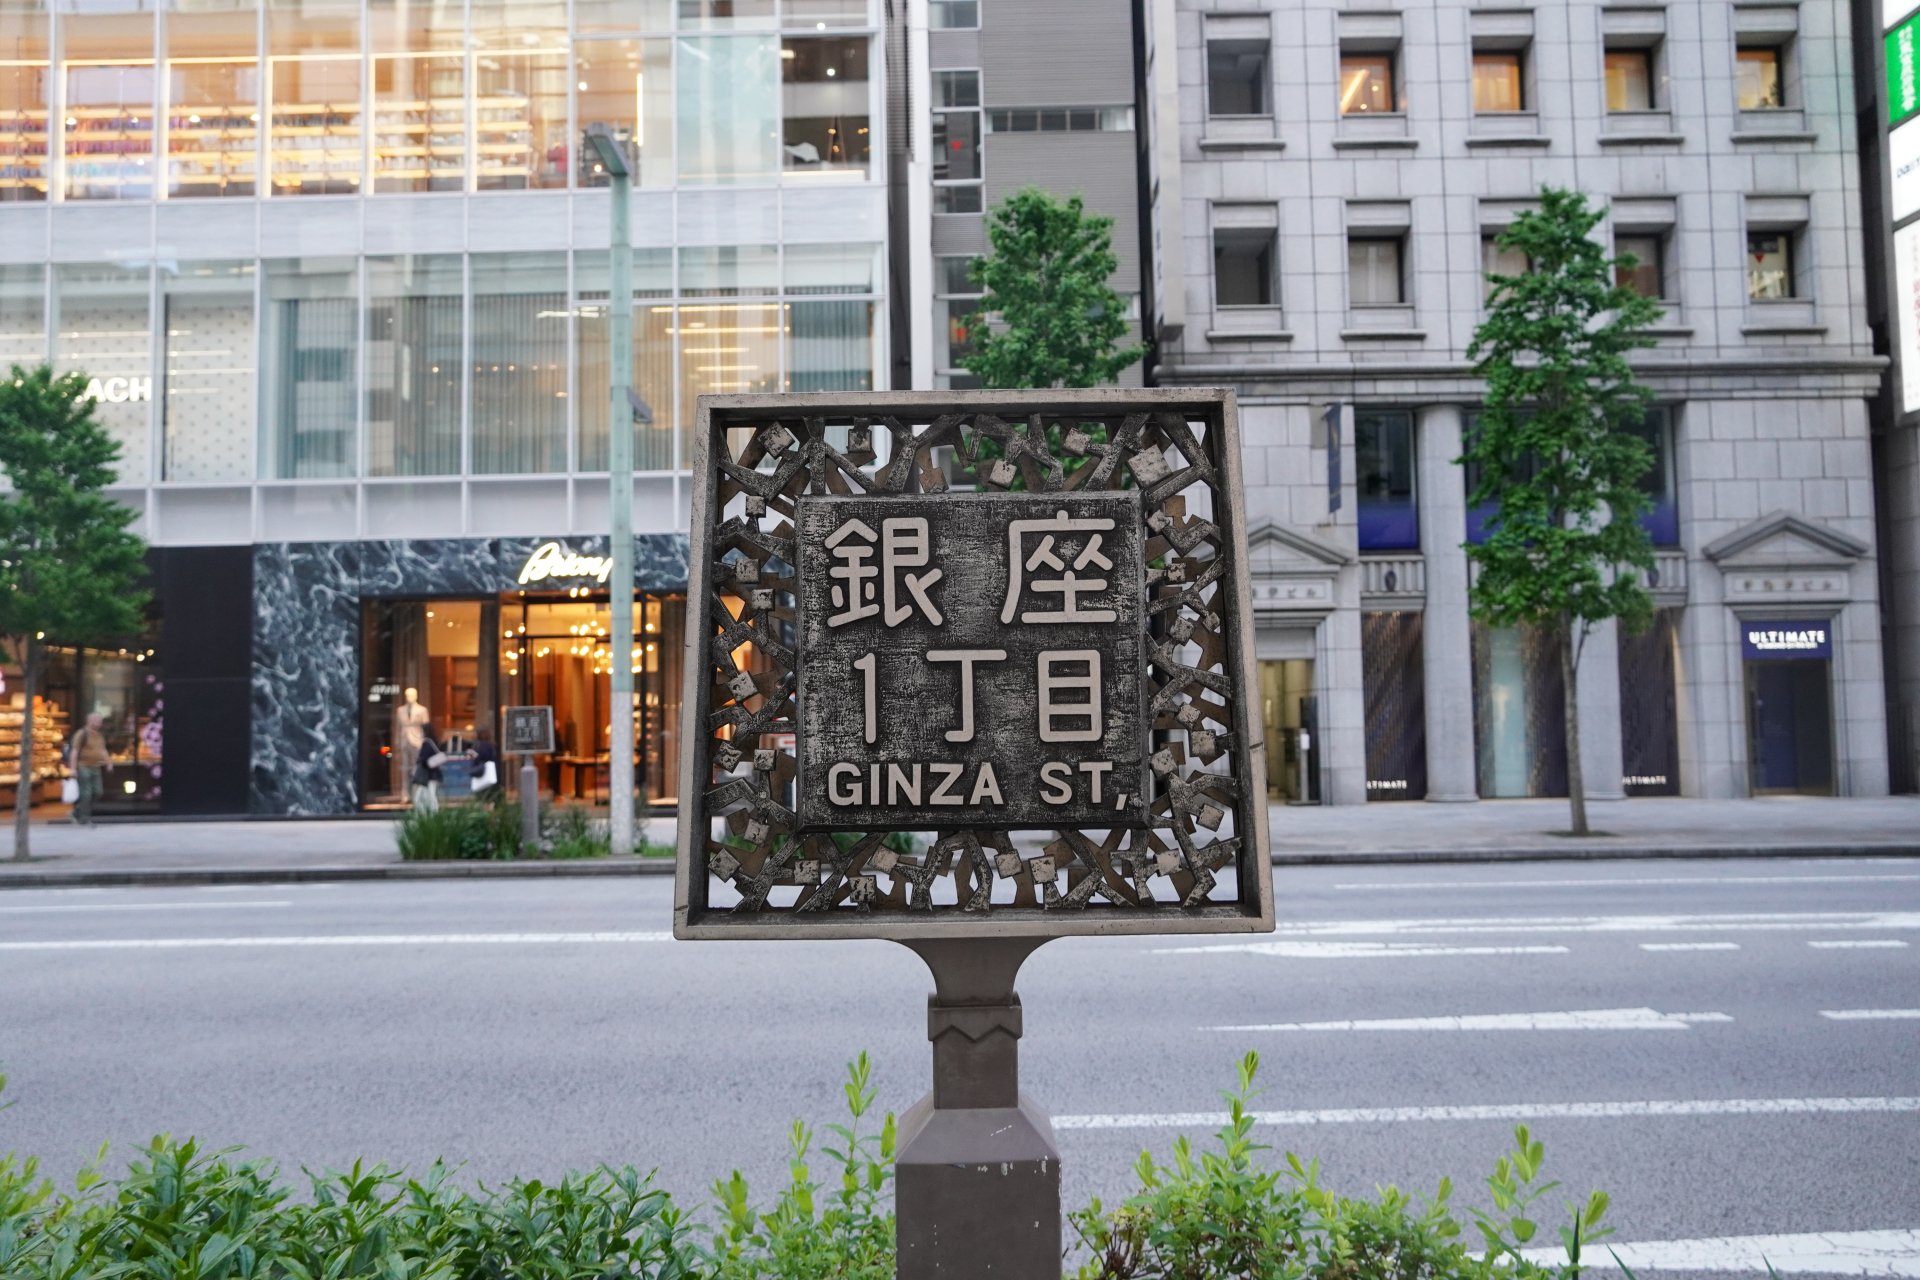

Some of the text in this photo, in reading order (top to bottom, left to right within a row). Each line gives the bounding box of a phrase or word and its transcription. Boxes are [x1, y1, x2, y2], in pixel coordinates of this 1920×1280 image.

[824, 510, 1117, 627] 銀座
[1748, 630, 1825, 643] ULTIMATE
[853, 649, 1102, 744] 1丁目
[828, 762, 1004, 806] GINZA
[1366, 780, 1407, 790] LTIMATE
